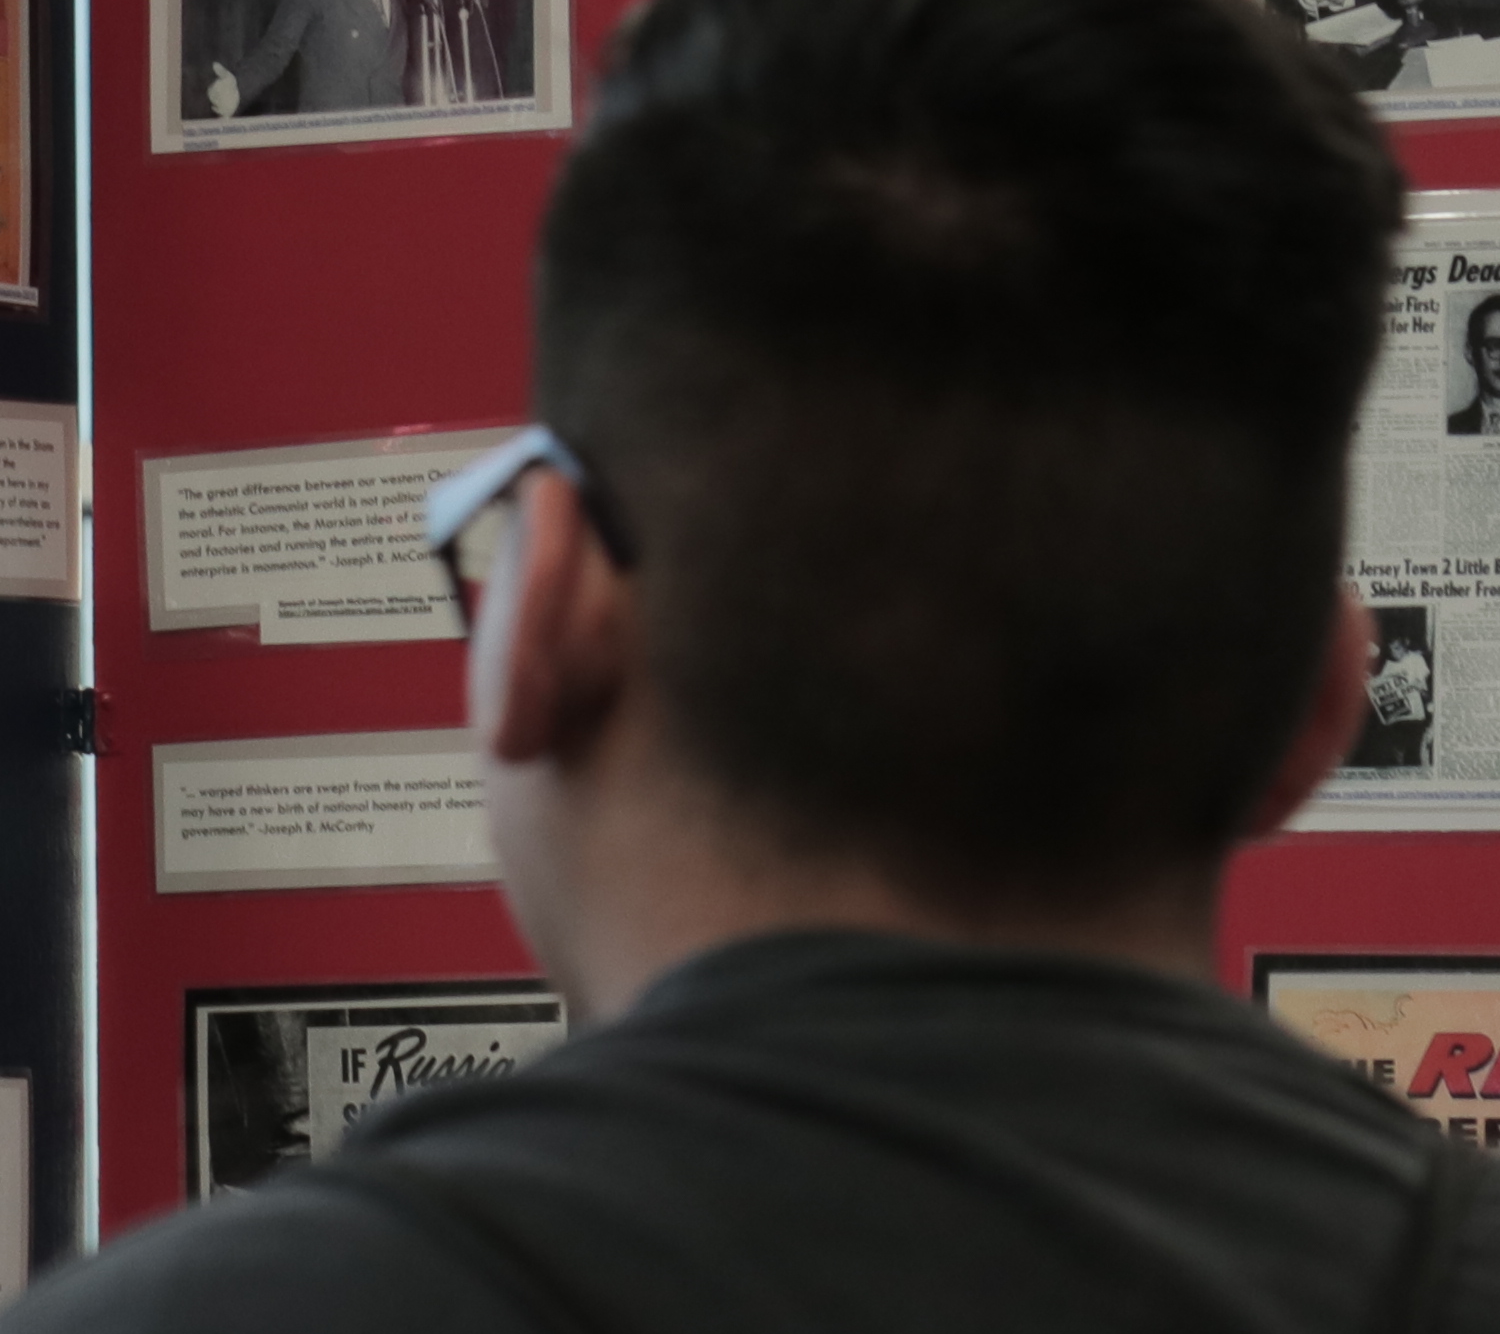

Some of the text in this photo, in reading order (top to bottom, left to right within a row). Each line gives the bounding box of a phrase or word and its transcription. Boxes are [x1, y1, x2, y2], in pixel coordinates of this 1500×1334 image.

[1412, 317, 1435, 334] Her
[1358, 558, 1400, 580] Jersey
[1403, 557, 1438, 575] Town
[1442, 557, 1451, 576] 2
[1455, 558, 1490, 575] Little
[1370, 581, 1415, 597] Shields
[1420, 580, 1470, 597] Brother
[198, 785, 243, 799] warped
[245, 784, 290, 795] thinkers
[292, 785, 313, 795] are
[316, 783, 350, 795] swept
[353, 780, 380, 792] from
[383, 779, 401, 791] the
[404, 778, 451, 790] national
[454, 780, 483, 789] scen
[341, 1048, 367, 1083] IF
